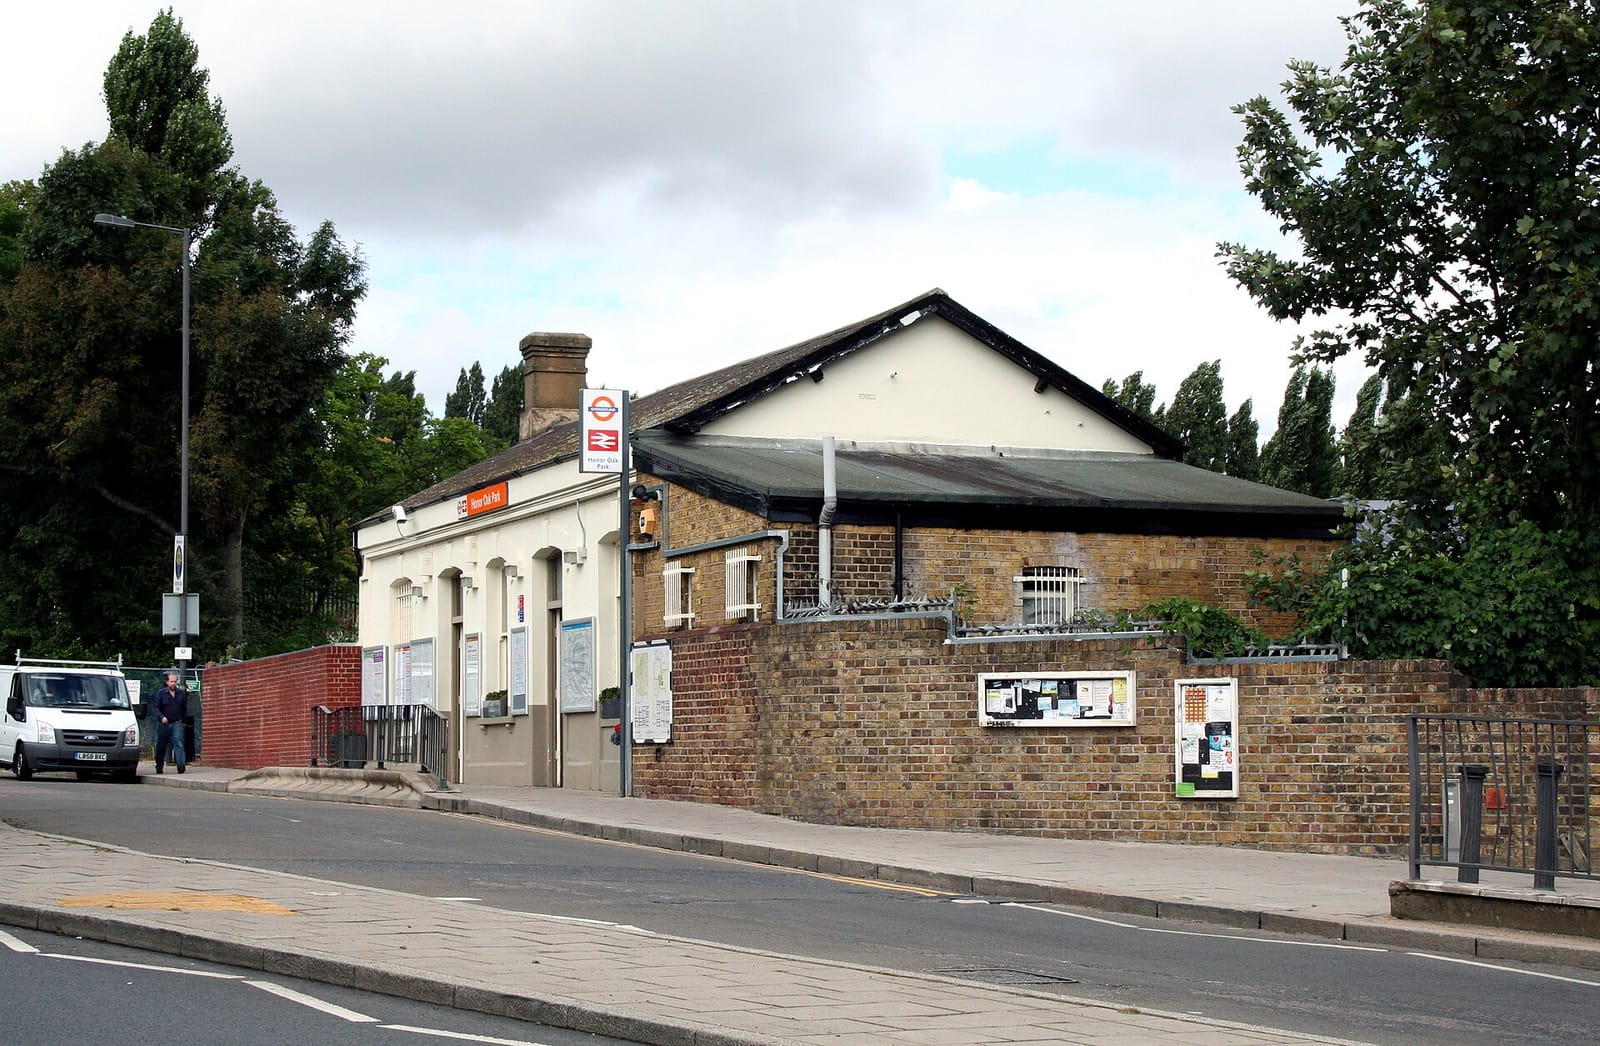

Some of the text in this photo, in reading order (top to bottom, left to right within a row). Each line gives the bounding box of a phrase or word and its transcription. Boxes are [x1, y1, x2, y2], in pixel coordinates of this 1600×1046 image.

[471, 490, 501, 511] Honor Oak Park
